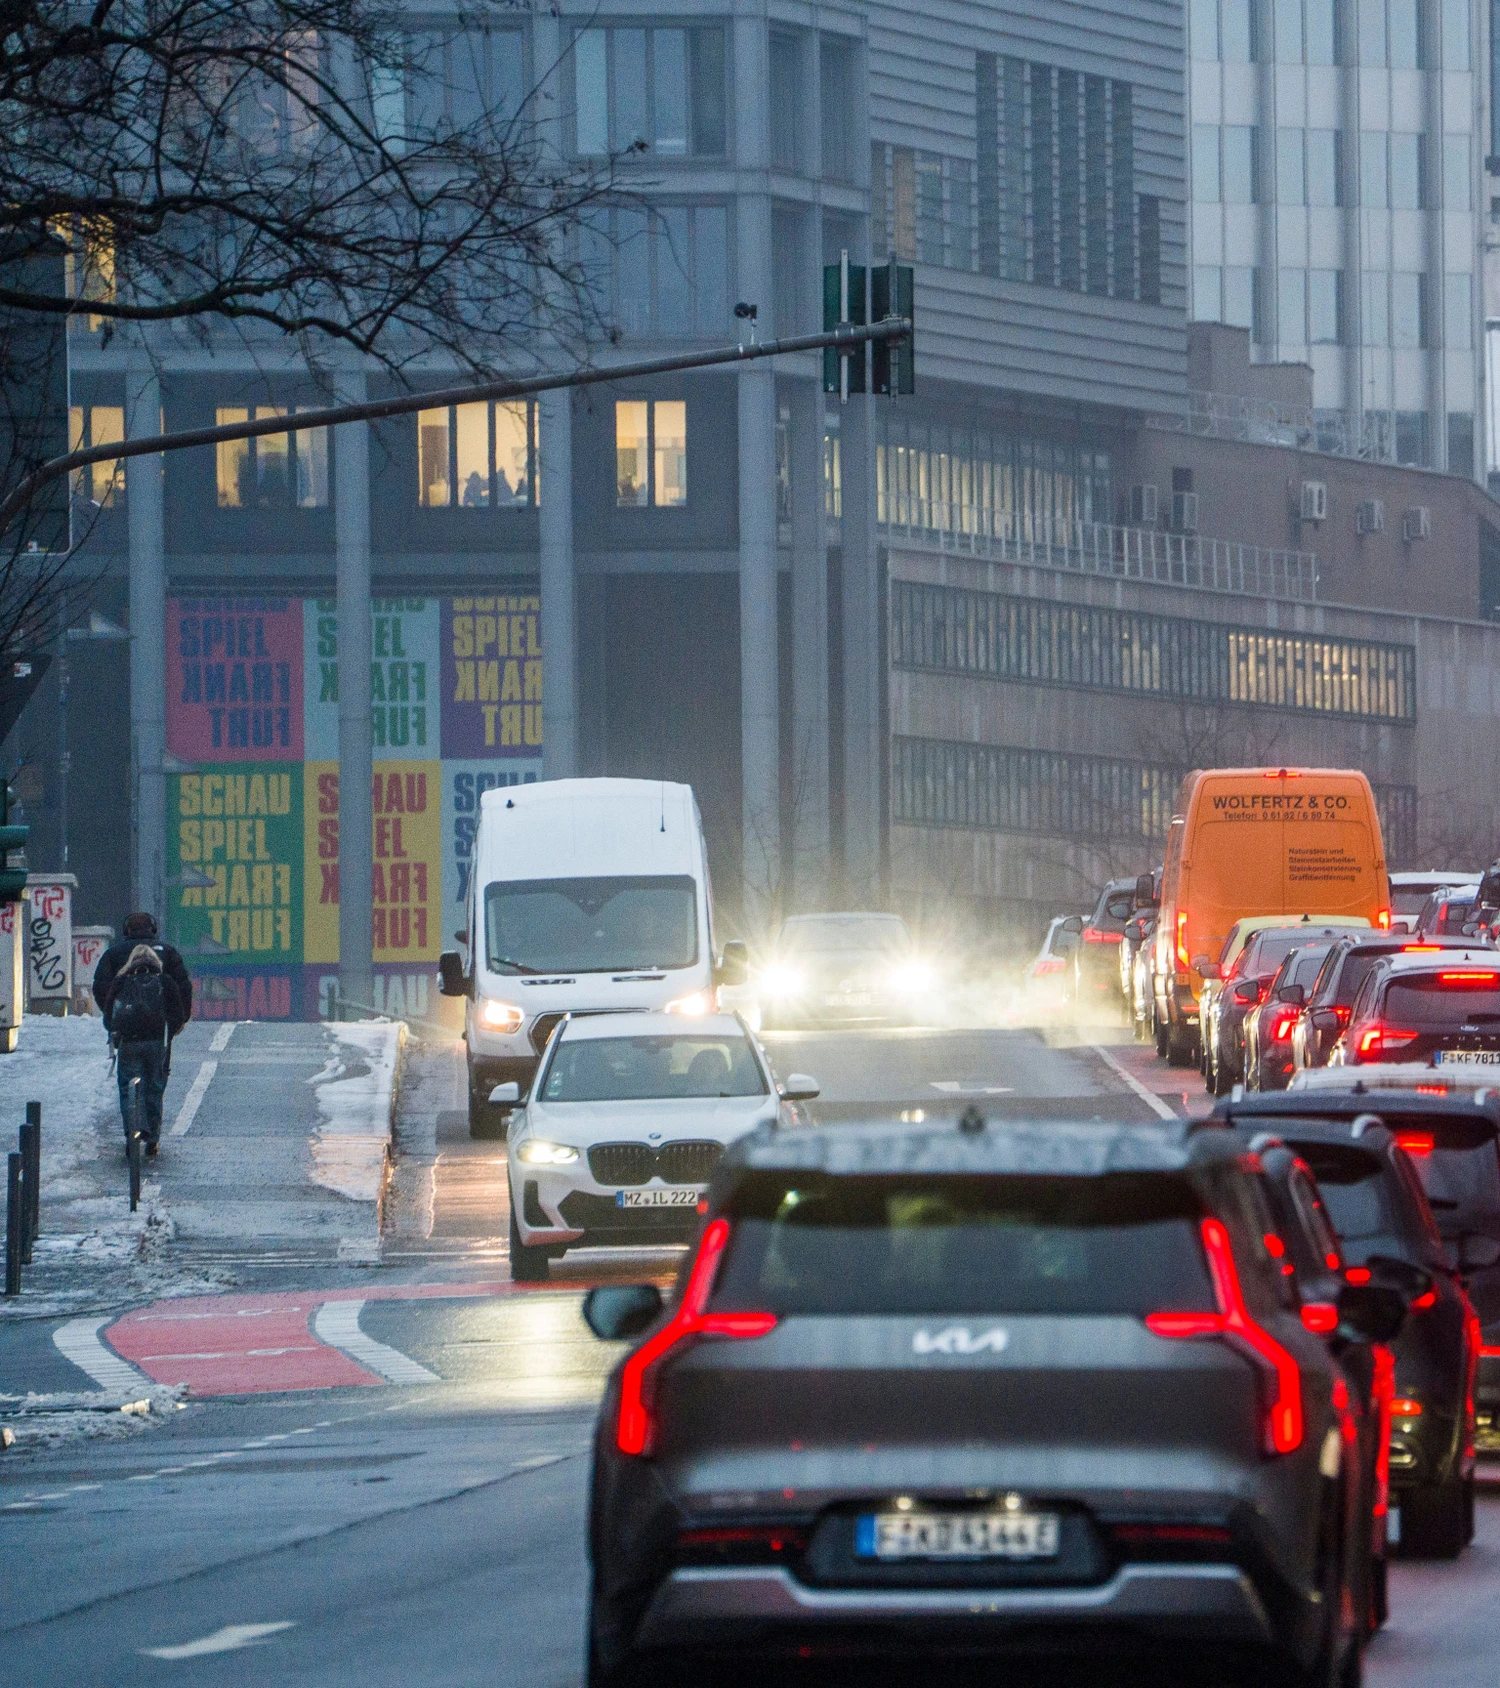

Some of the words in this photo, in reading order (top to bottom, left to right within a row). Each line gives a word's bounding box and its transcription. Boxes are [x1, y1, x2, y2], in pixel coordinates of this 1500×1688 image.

[180, 617, 270, 657] SPIEL
[453, 615, 542, 657] SPIEL
[180, 774, 290, 815] SCHAU
[1213, 796, 1303, 809] WOLFERTZ
[1308, 796, 1319, 809] &
[1323, 796, 1351, 809] CO.
[1224, 811, 1257, 820] Telefon
[180, 819, 271, 861] SPIEL
[1442, 1053, 1448, 1063] F
[624, 1193, 642, 1205] MZ
[671, 1191, 696, 1204] 222
